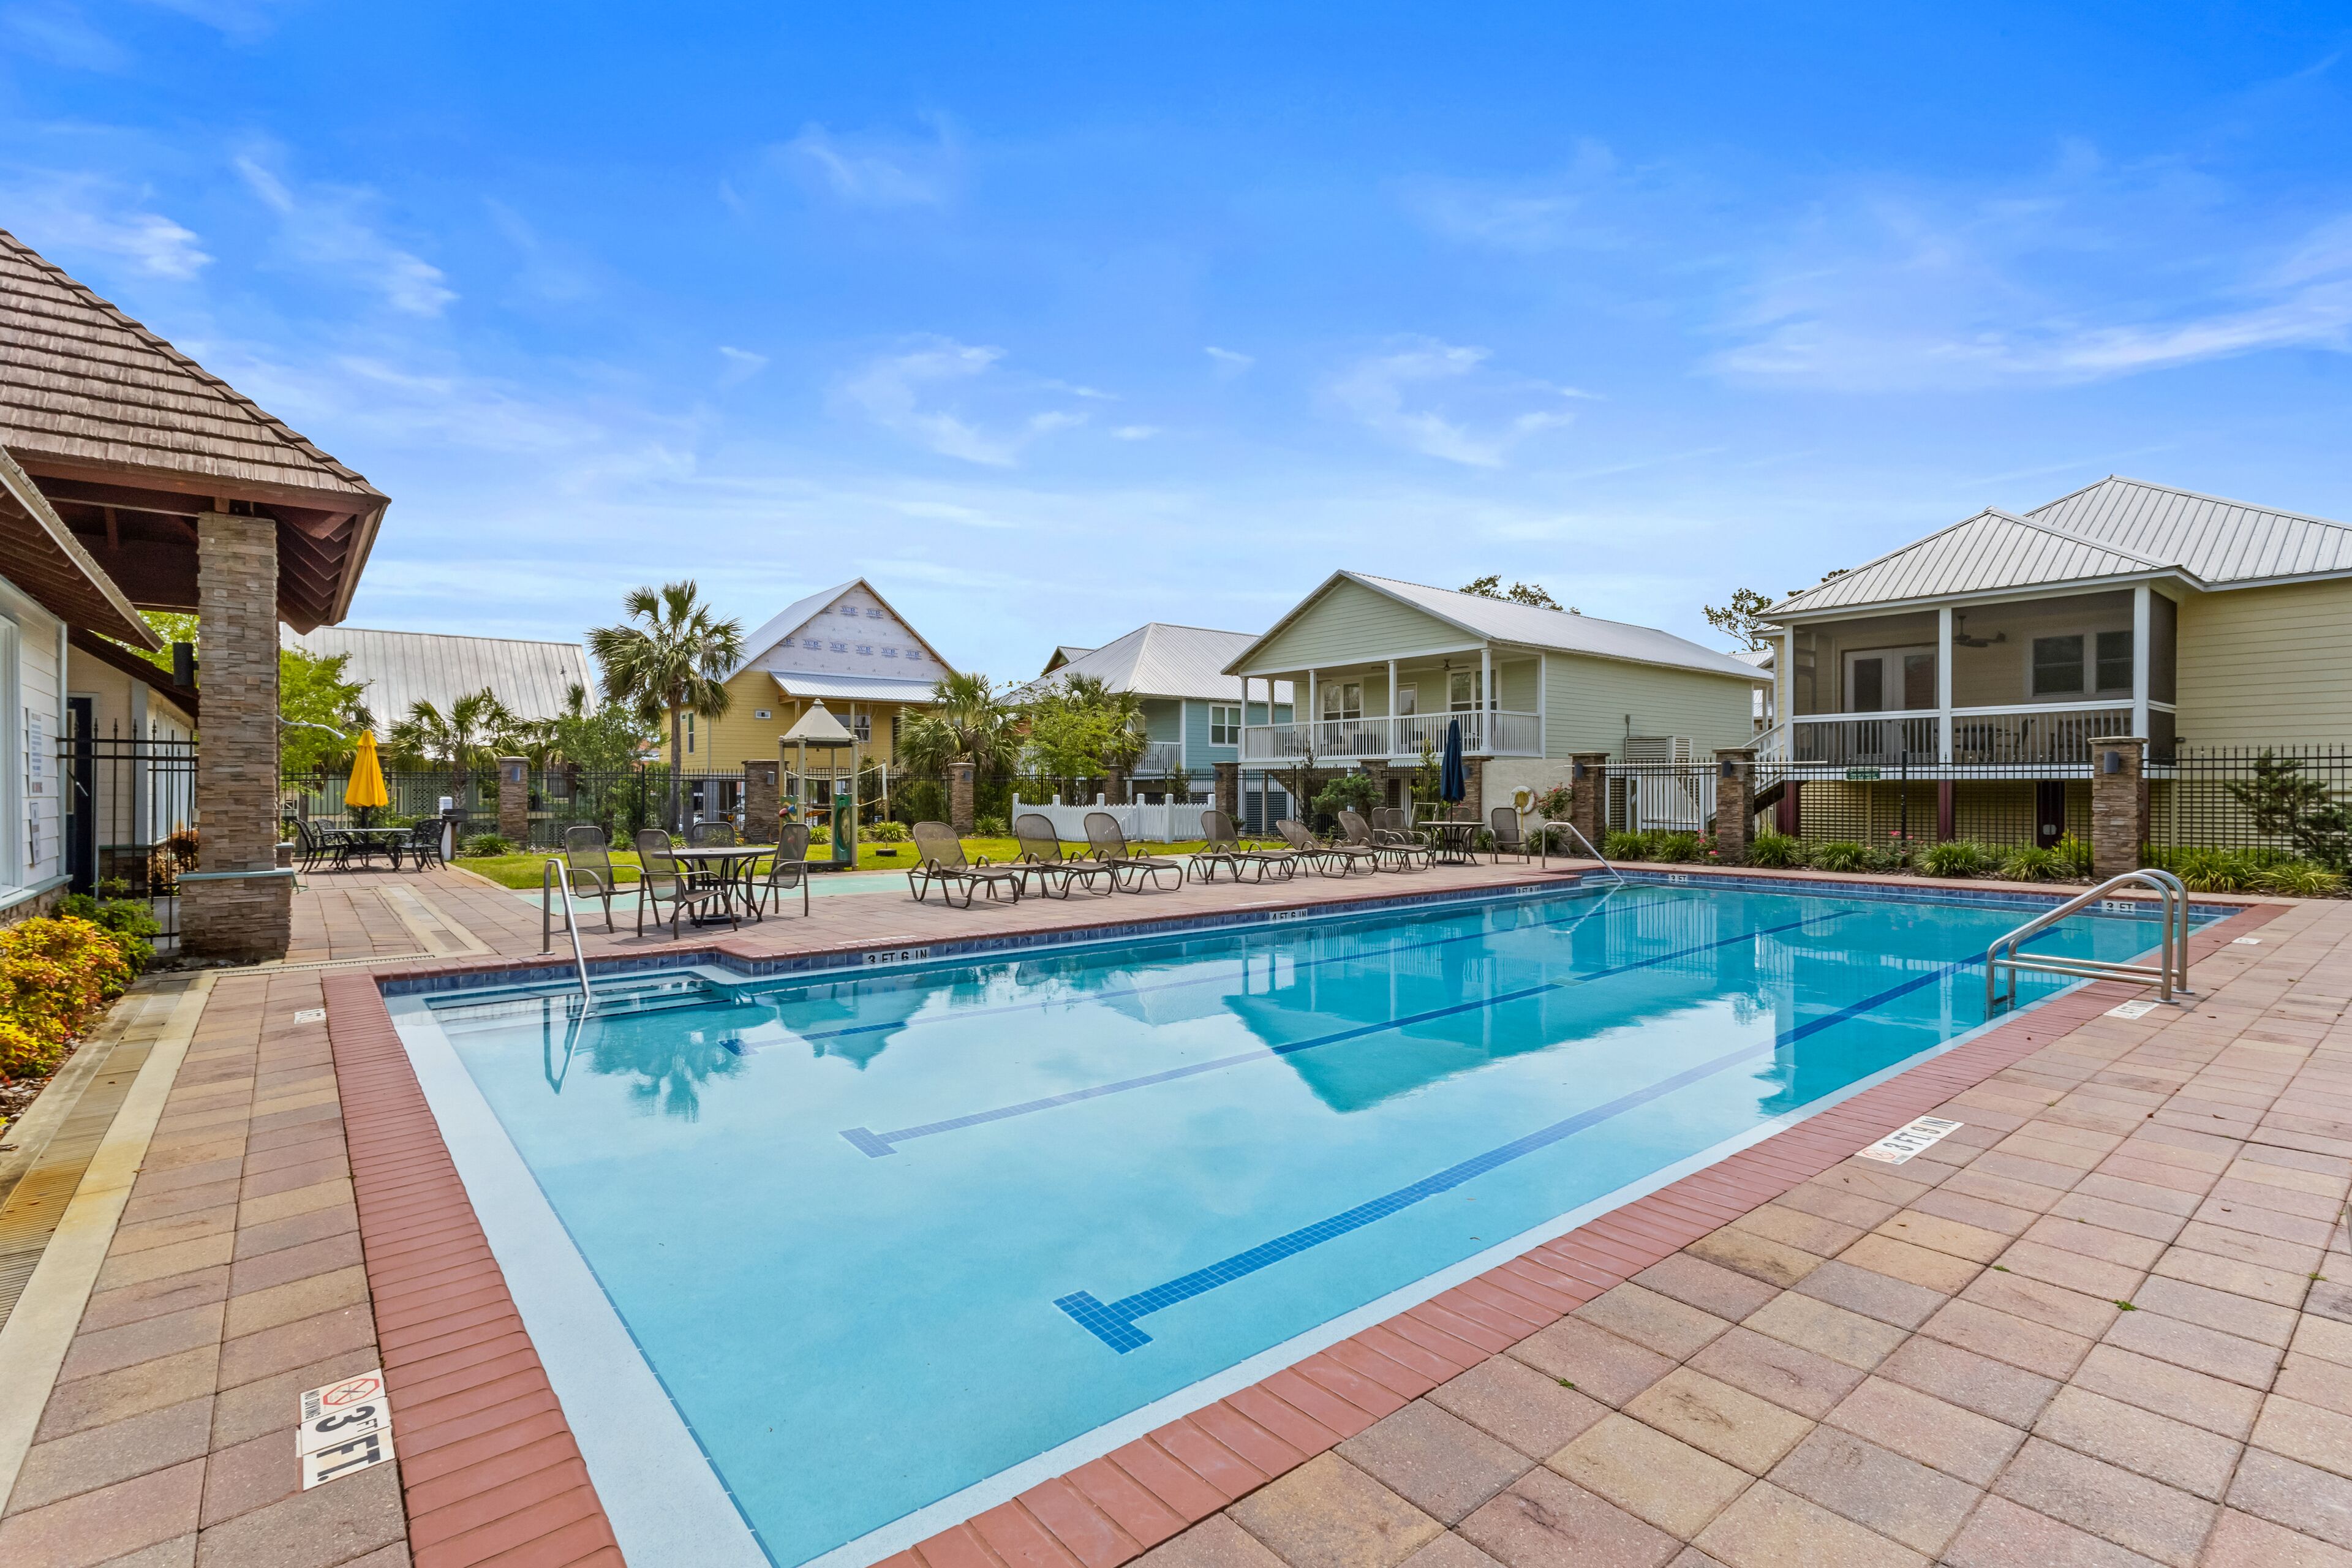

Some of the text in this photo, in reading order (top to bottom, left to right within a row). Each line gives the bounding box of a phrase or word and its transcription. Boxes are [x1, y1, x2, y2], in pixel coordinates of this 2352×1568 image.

[882, 952, 895, 962] FT
[902, 951, 909, 960] 6
[916, 949, 927, 959] IN
[1882, 1142, 1914, 1151] 3
[304, 1390, 321, 1419] NO DIVING
[315, 1406, 381, 1482] 3 FT FT.
